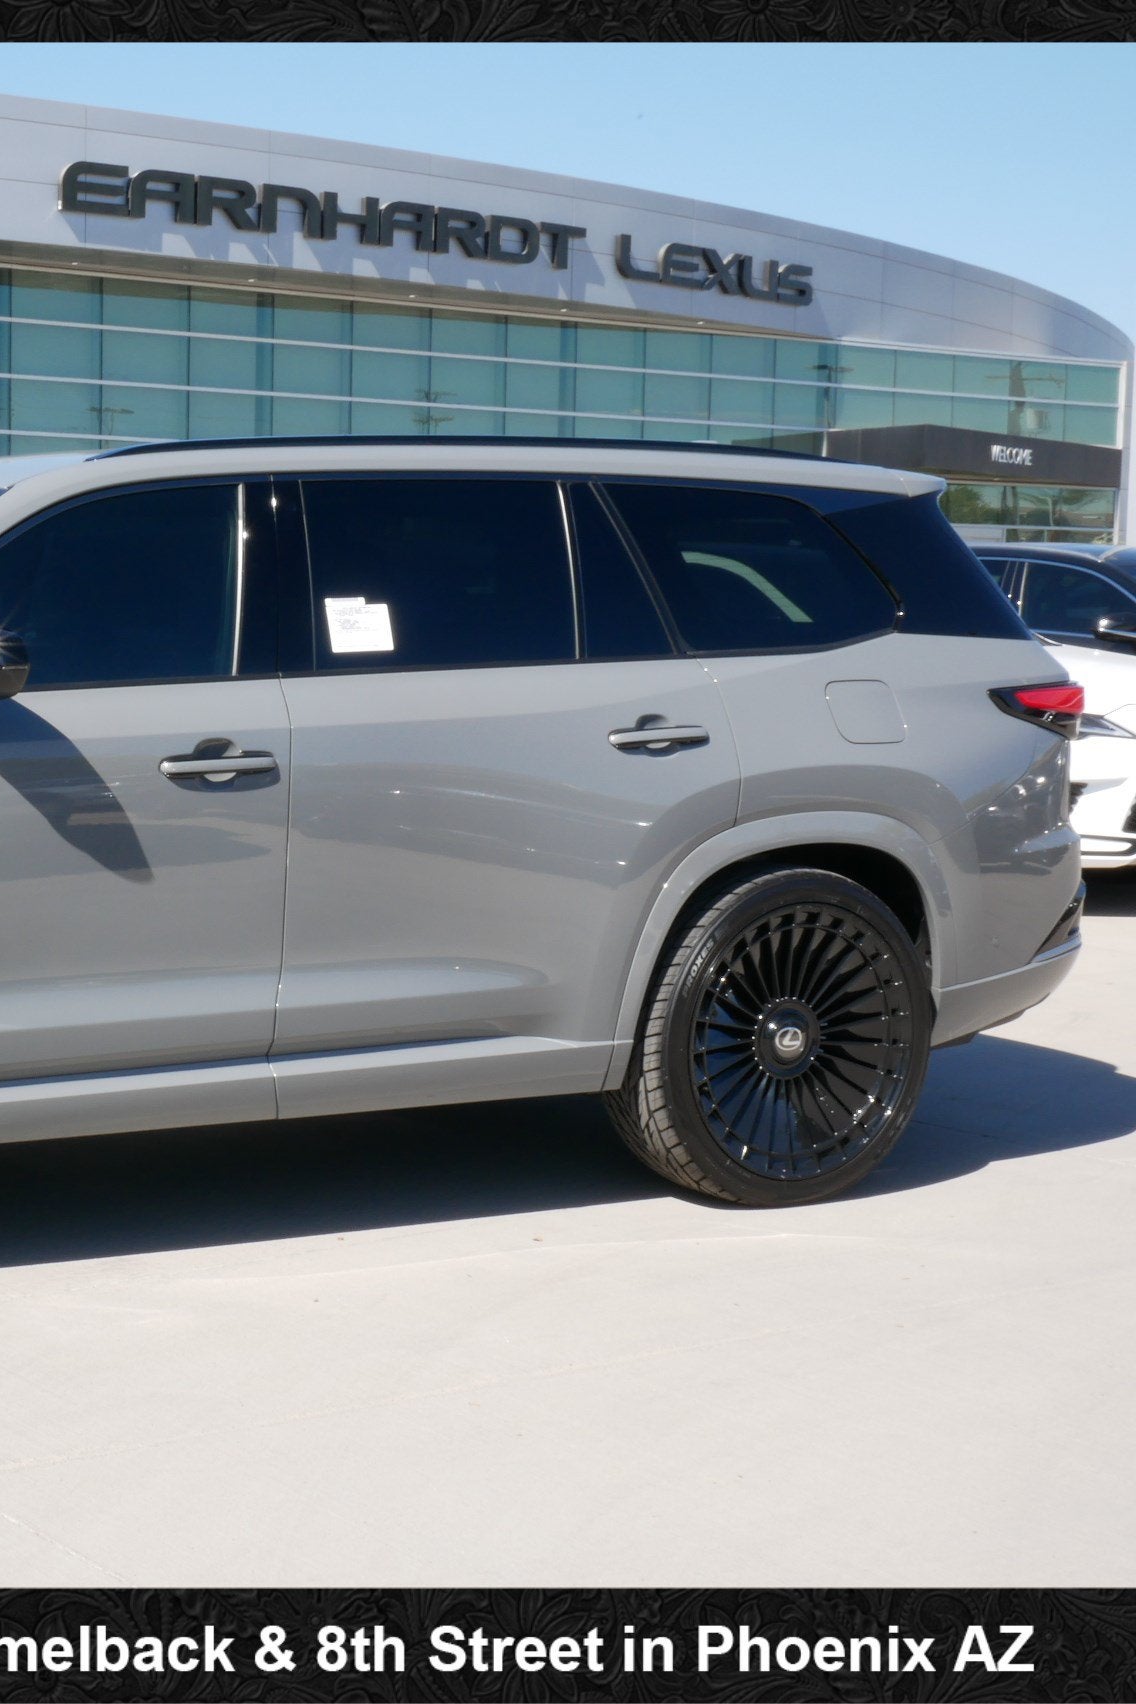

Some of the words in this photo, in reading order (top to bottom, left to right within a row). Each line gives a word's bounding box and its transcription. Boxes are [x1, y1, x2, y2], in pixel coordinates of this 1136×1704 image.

[58, 160, 587, 271] EARNHARDT
[616, 233, 814, 306] LEXUS
[990, 444, 1033, 466] WELCOME
